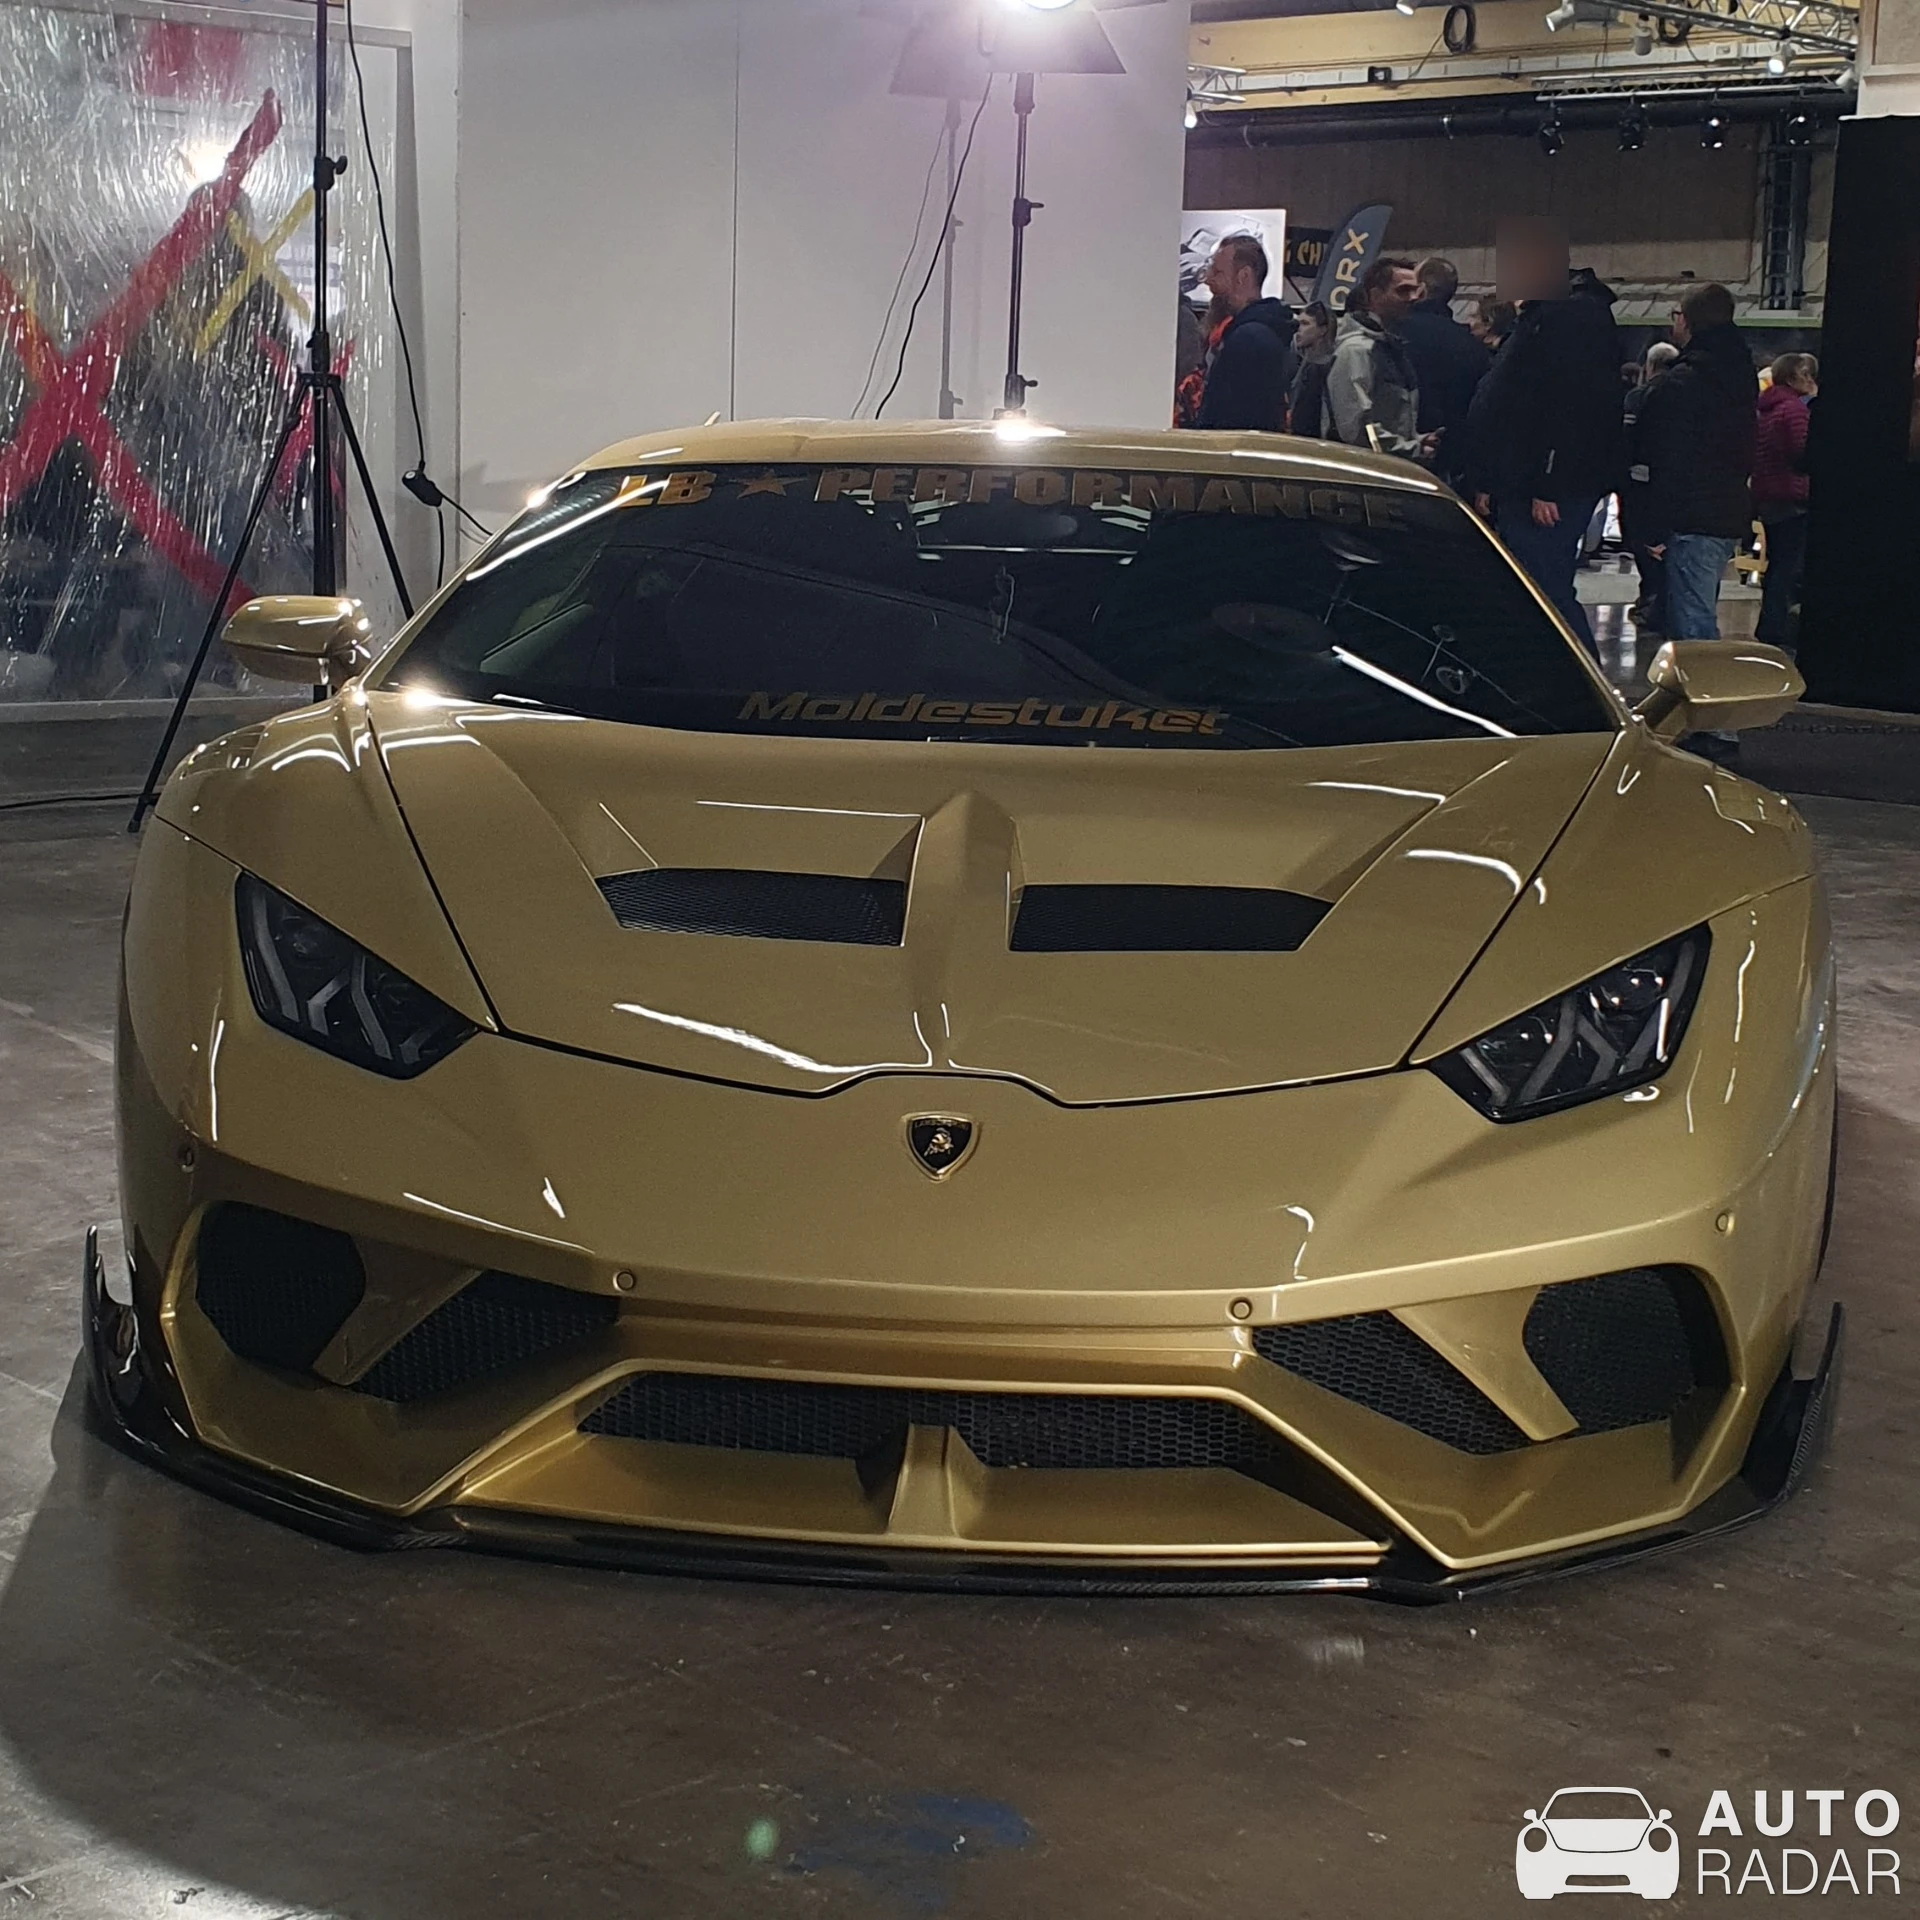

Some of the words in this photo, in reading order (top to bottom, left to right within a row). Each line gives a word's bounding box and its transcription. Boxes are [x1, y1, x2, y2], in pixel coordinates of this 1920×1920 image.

[617, 470, 717, 507] LB
[814, 467, 1407, 532] PERFORMANCE
[737, 692, 1227, 735] Moldestuket
